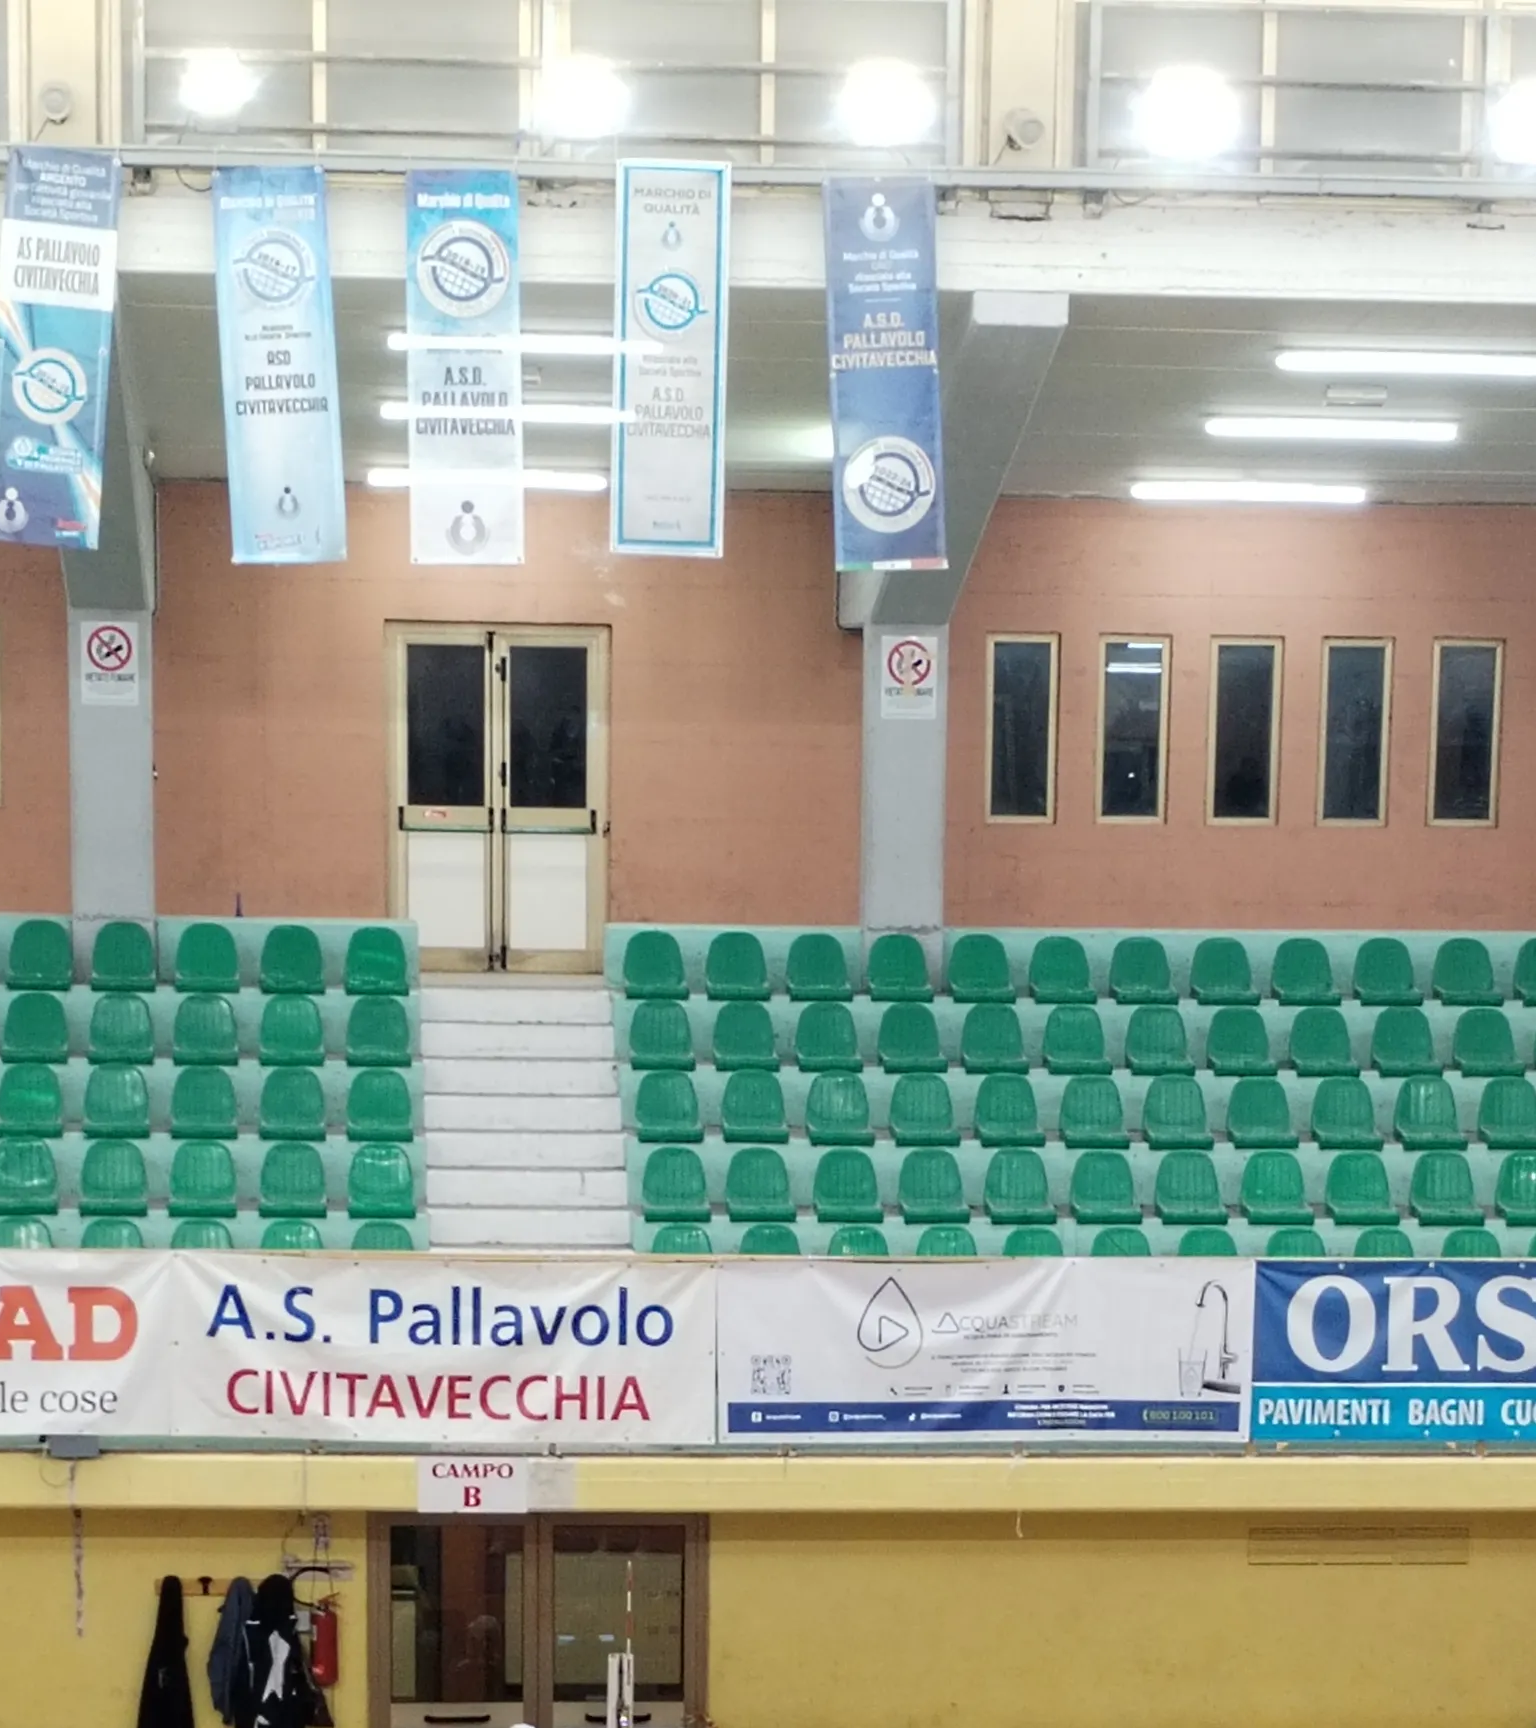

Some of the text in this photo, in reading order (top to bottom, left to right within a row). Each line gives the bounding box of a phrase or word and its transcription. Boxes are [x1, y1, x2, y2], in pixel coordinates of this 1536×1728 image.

[634, 187, 695, 200] MARCHIO
[643, 202, 700, 216] QUALITÀ
[16, 236, 101, 268] AS PALLAVOLO
[13, 264, 100, 297] CIVITAVECCHIA
[843, 330, 926, 350] PALLAVOLO
[831, 349, 938, 371] CIVITAVECCHIA
[245, 372, 317, 391] PALLAVOLO
[235, 396, 330, 416] CIVITAVECCHIA
[634, 404, 705, 422] PALLAVOLO
[415, 416, 516, 437] CIVITAVECCHIA
[626, 421, 712, 440] CIVITAVECCHIA
[206, 1283, 675, 1347] A.S. Pallavolo
[39, 1386, 118, 1414] cose
[226, 1367, 651, 1421] CIVITAVECCHIA
[1257, 1400, 1390, 1426] PAVIMENTI
[1407, 1399, 1485, 1427] BAGNI
[432, 1463, 514, 1479] CAMPO
[462, 1487, 481, 1508] B
